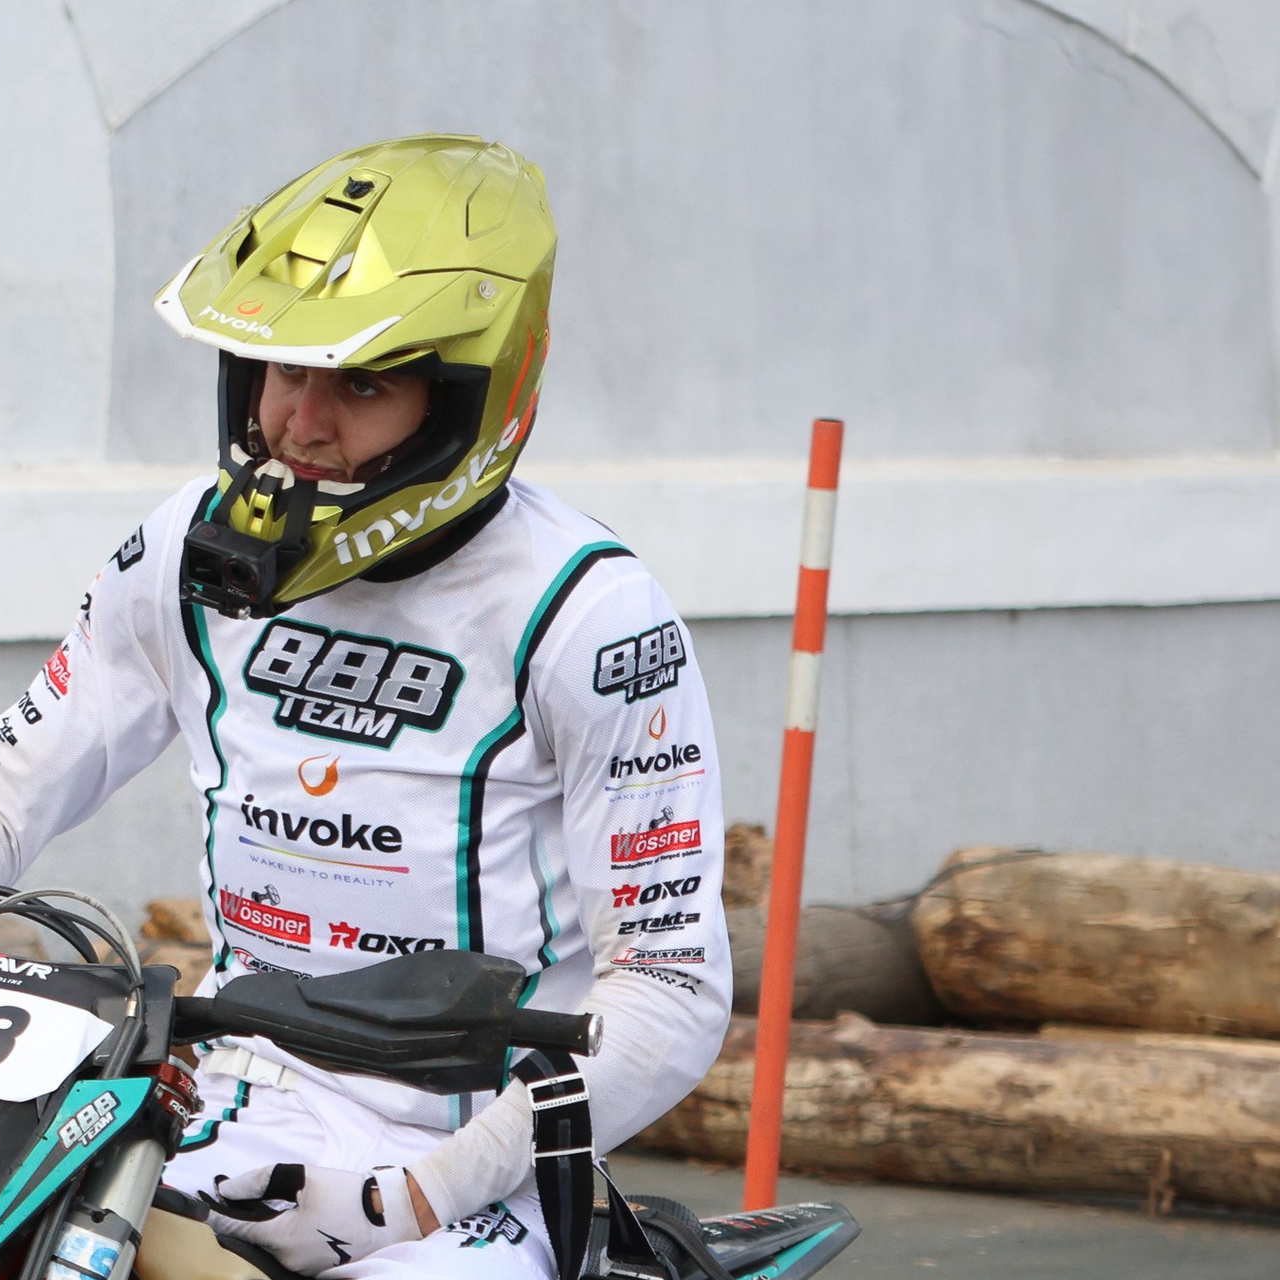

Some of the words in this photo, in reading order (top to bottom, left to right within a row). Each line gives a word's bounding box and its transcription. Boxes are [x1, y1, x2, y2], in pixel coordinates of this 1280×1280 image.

[333, 417, 520, 566] invoke
[249, 624, 451, 717] 888
[597, 624, 684, 689] 888
[623, 664, 675, 699] TEAM
[279, 690, 398, 740] TEAM
[609, 742, 701, 779] invoke
[241, 794, 403, 853] invoke
[616, 823, 699, 858] Wössner
[249, 854, 285, 871] WAKE
[288, 866, 306, 875] UP
[310, 869, 329, 880] TO
[333, 873, 395, 888] REALITY
[221, 884, 308, 937] Wössner
[59, 1091, 117, 1149] 888
[78, 1111, 114, 1146] TEAM
